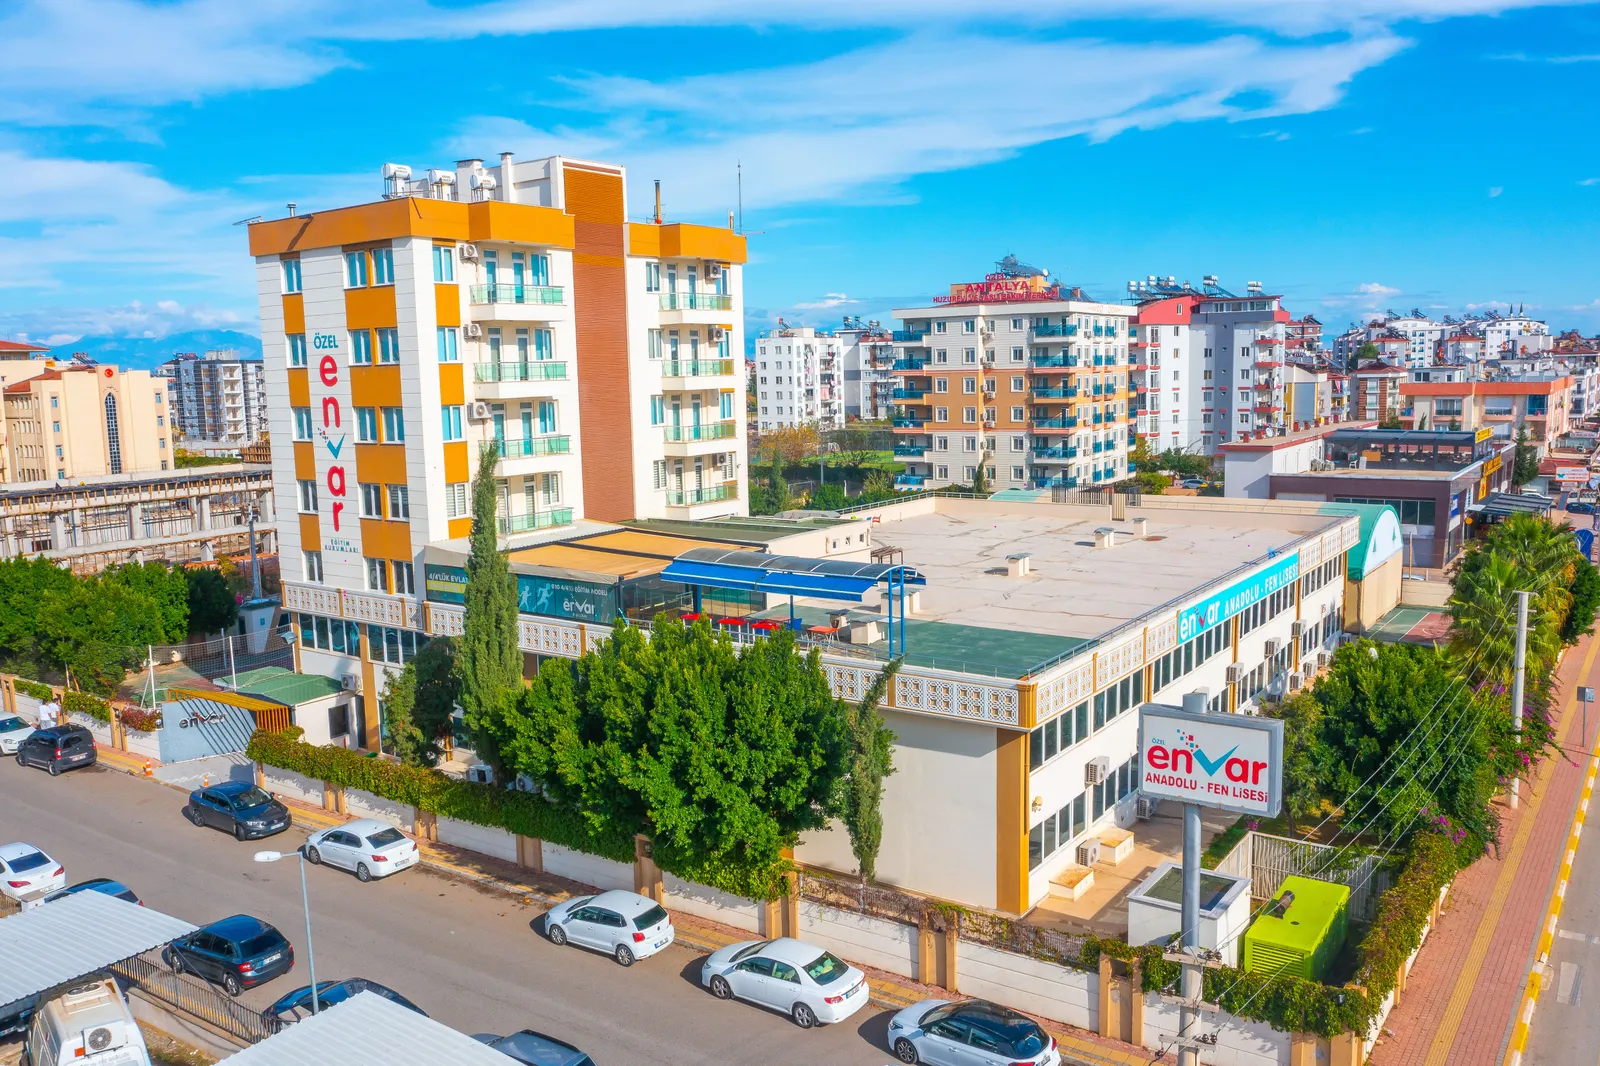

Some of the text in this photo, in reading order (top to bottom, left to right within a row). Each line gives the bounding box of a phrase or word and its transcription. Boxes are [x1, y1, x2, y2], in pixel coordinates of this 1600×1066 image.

[966, 281, 1029, 293] ANTALYA
[313, 332, 339, 349] ÖZEL
[1224, 584, 1260, 617] ANADOLU
[1264, 574, 1278, 594] FEN
[1151, 738, 1166, 746] ÖZEL
[1145, 772, 1198, 791] ANADOLU
[1207, 782, 1229, 796] FEN
